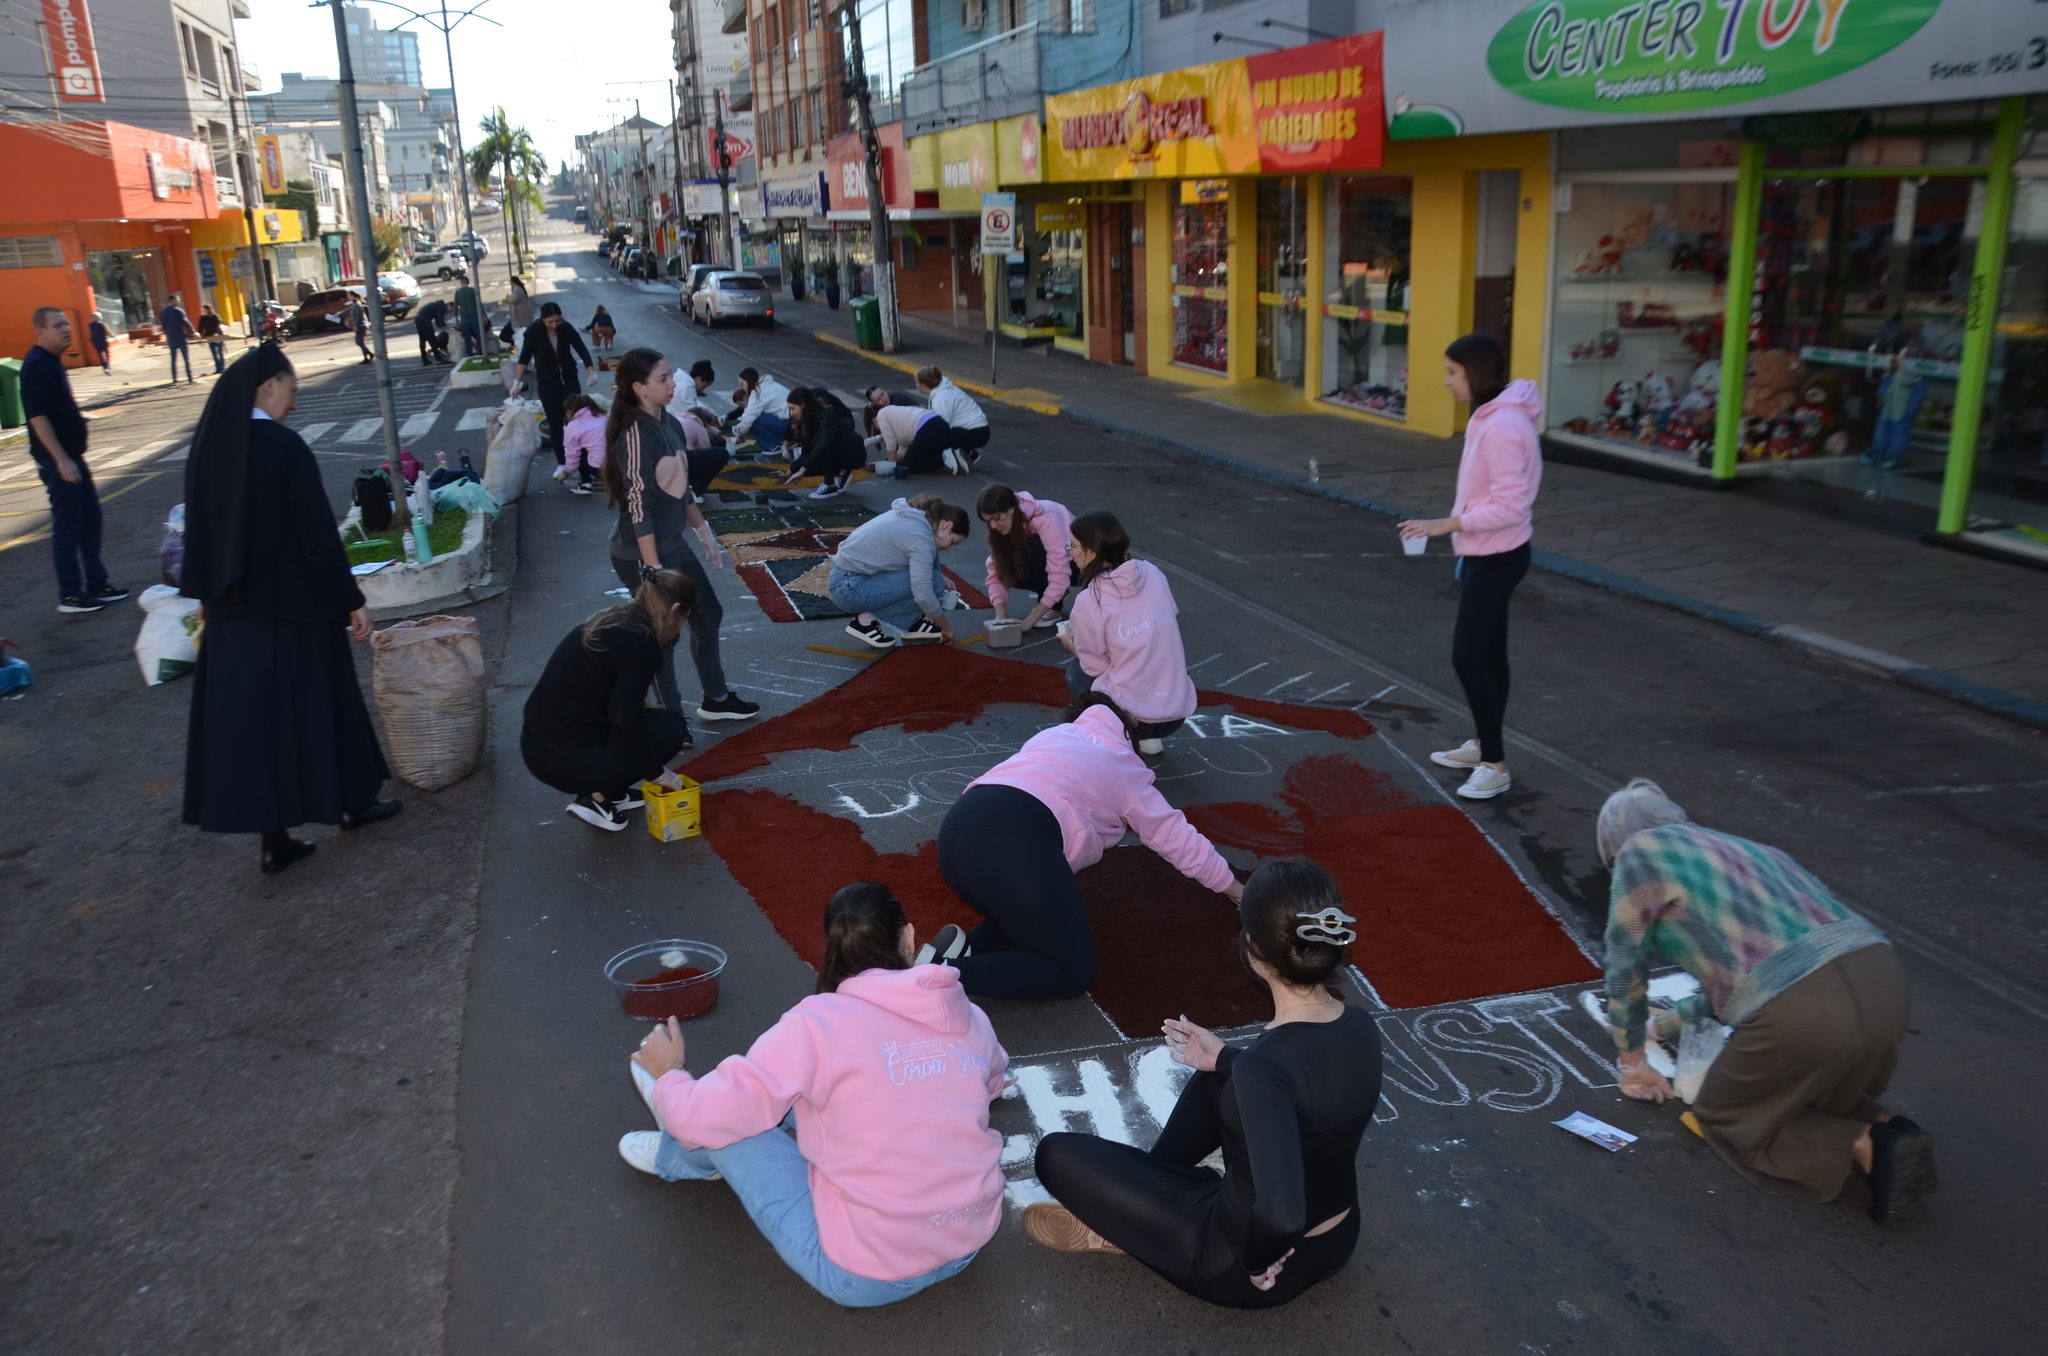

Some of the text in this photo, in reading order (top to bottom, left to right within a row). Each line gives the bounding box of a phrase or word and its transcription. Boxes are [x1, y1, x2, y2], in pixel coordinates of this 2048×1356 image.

[1254, 65, 1364, 109] UM MUNDO DE
[1595, 61, 1767, 101] Papelaria & Brinquedos
[1259, 107, 1357, 146] VARIEDADES
